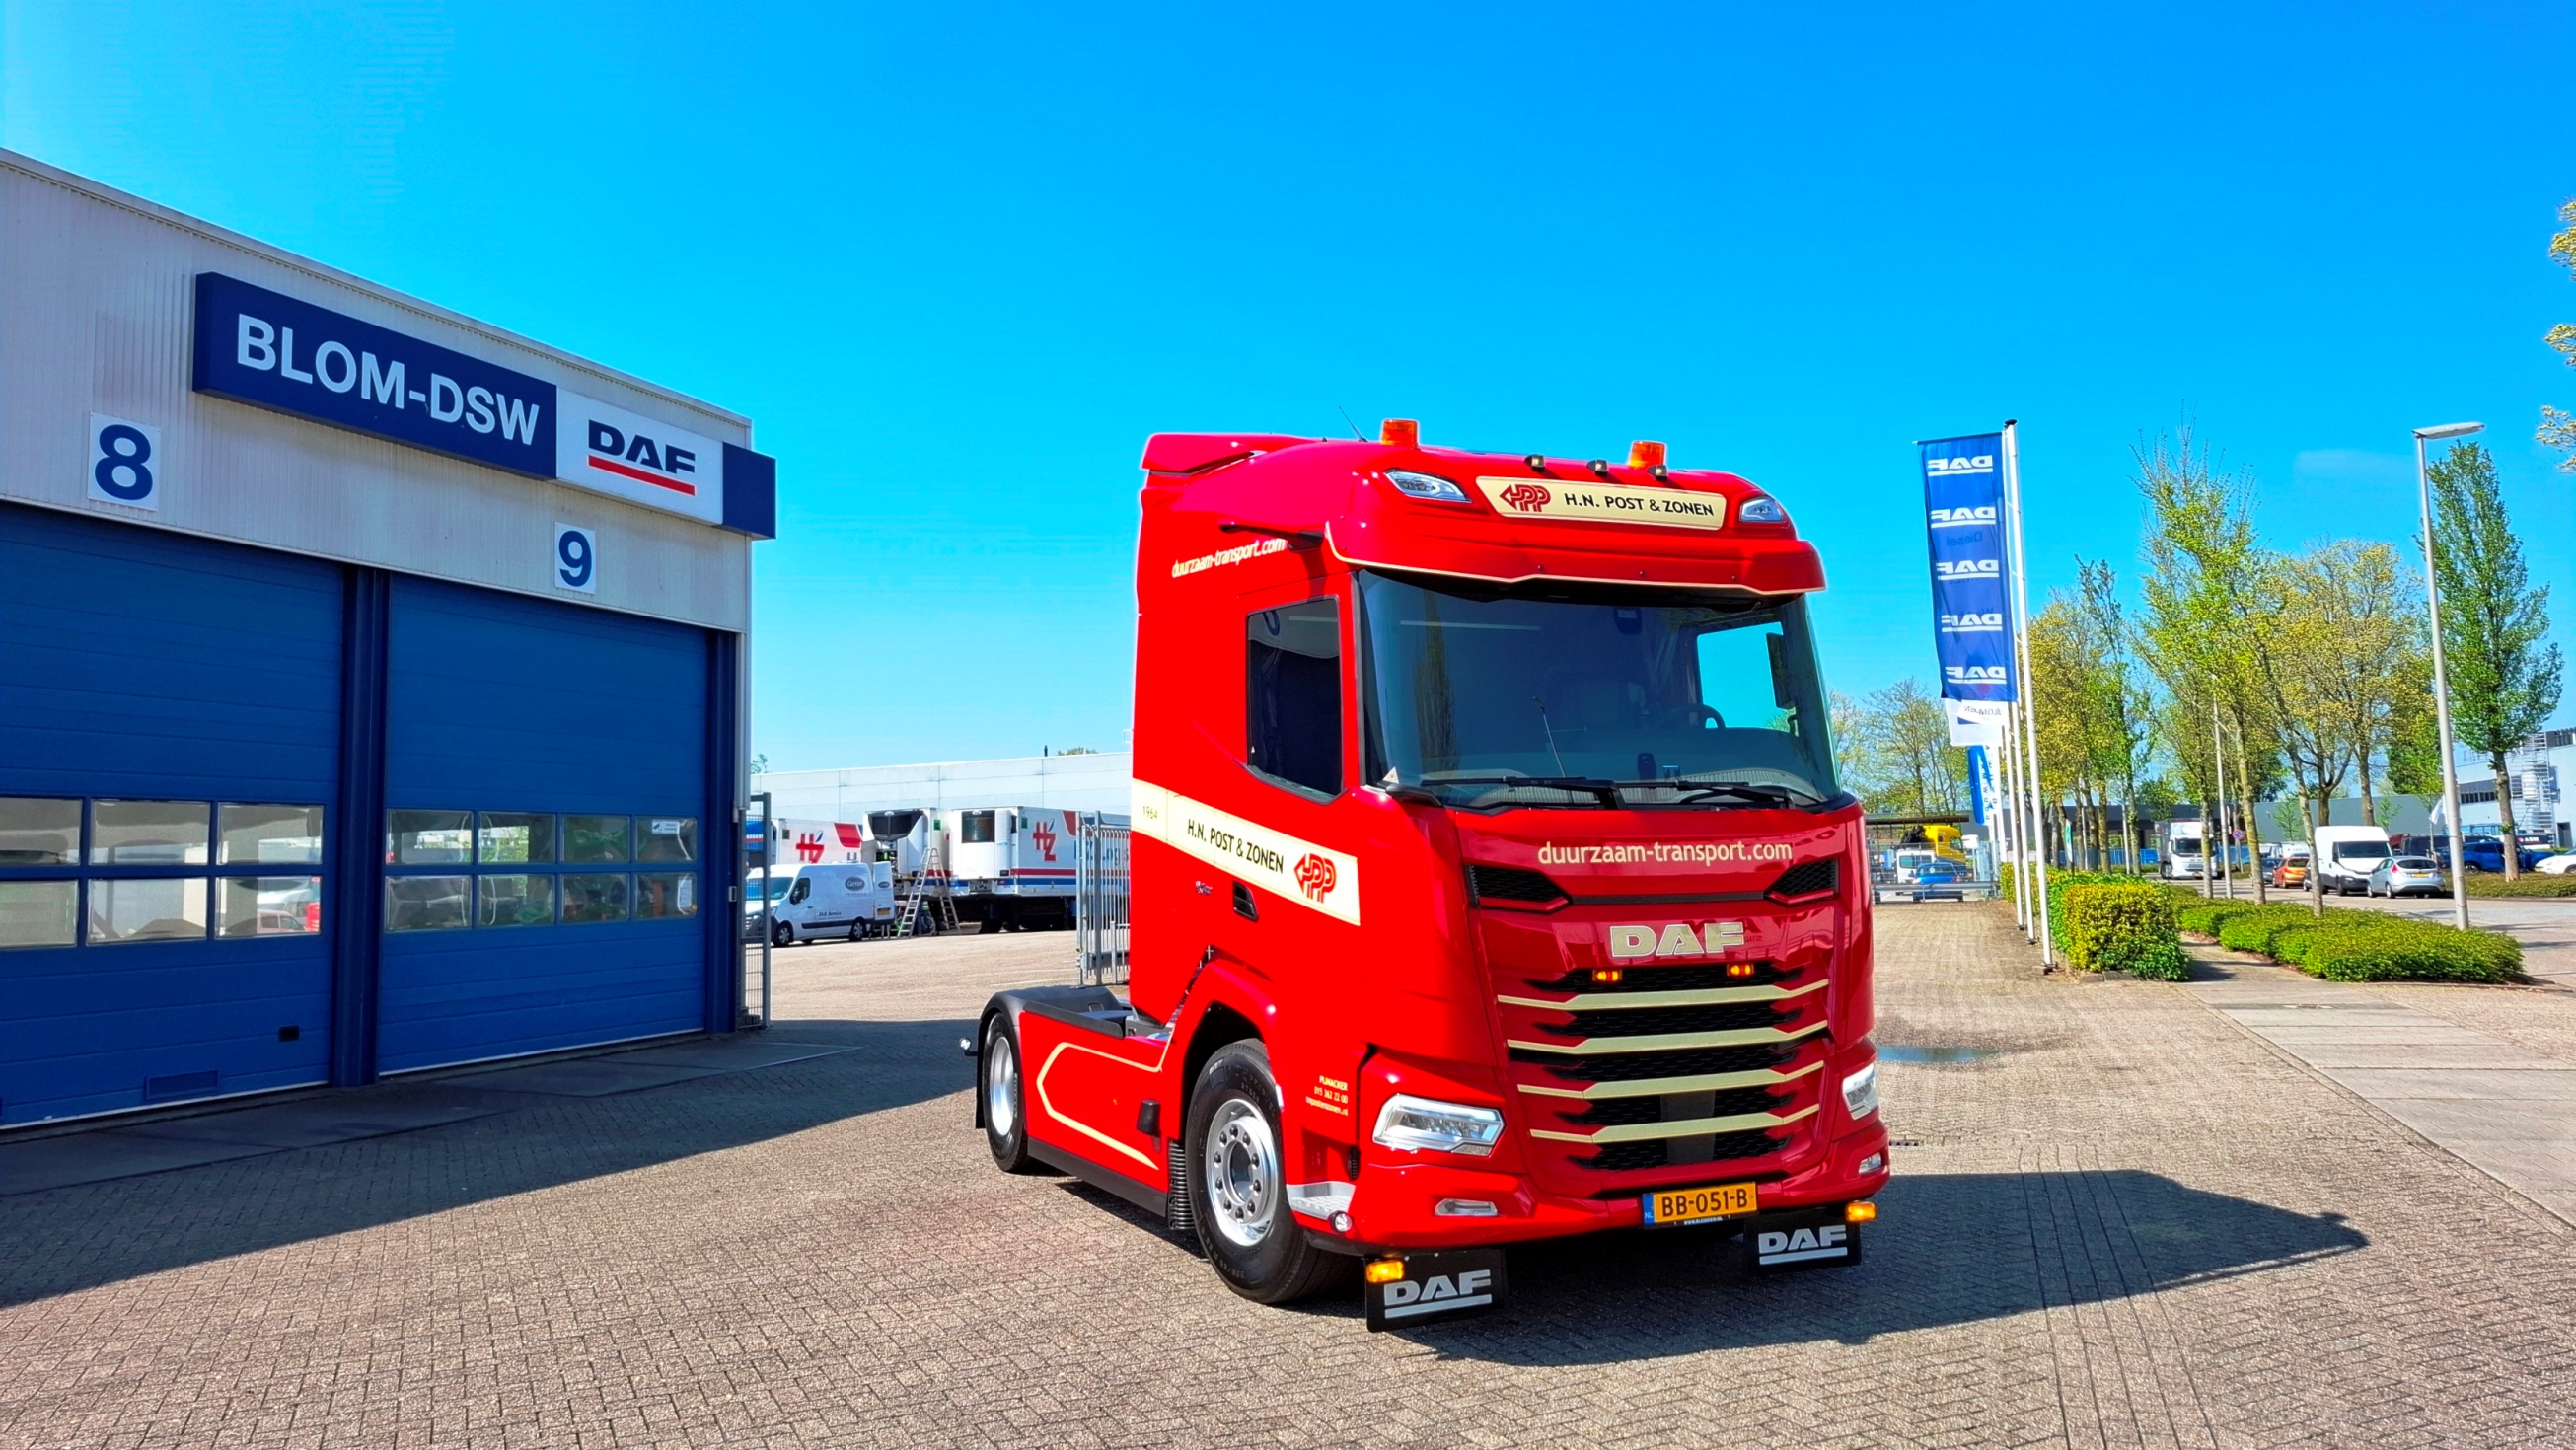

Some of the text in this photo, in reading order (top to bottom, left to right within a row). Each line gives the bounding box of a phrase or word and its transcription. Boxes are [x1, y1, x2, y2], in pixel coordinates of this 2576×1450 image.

[238, 314, 539, 445] BLOM-DSW
[95, 424, 153, 501] 8
[589, 419, 696, 475] DAF
[1564, 493, 1715, 516] H.N. POST & ZONEN
[558, 530, 592, 588] 9
[1172, 538, 1288, 578] duurzaam-transport.com
[1187, 818, 1284, 874] H.N. POST & ZONEN
[1537, 840, 1793, 866] duurzaam-transport.com
[1610, 921, 1744, 957] DAF
[1661, 1188, 1748, 1217] BB-051-B
[1758, 1224, 1847, 1254] DAF
[1383, 1269, 1491, 1306] DAF
